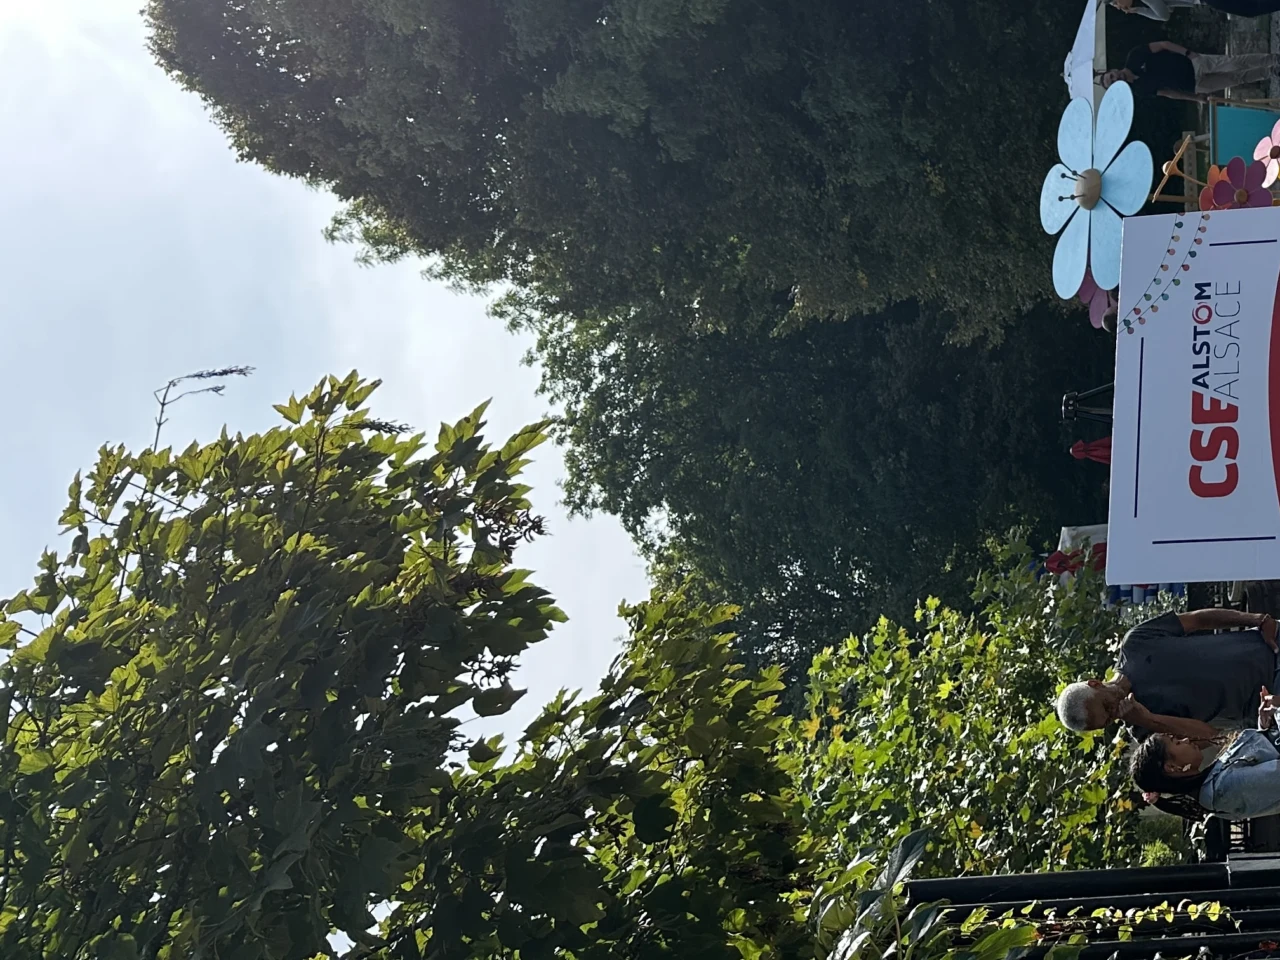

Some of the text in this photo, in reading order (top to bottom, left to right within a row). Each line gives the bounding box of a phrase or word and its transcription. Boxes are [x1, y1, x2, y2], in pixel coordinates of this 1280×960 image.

[1192, 282, 1213, 390] ALSTOM
[1213, 281, 1240, 400] ALSACE
[1189, 390, 1240, 498] CSE
